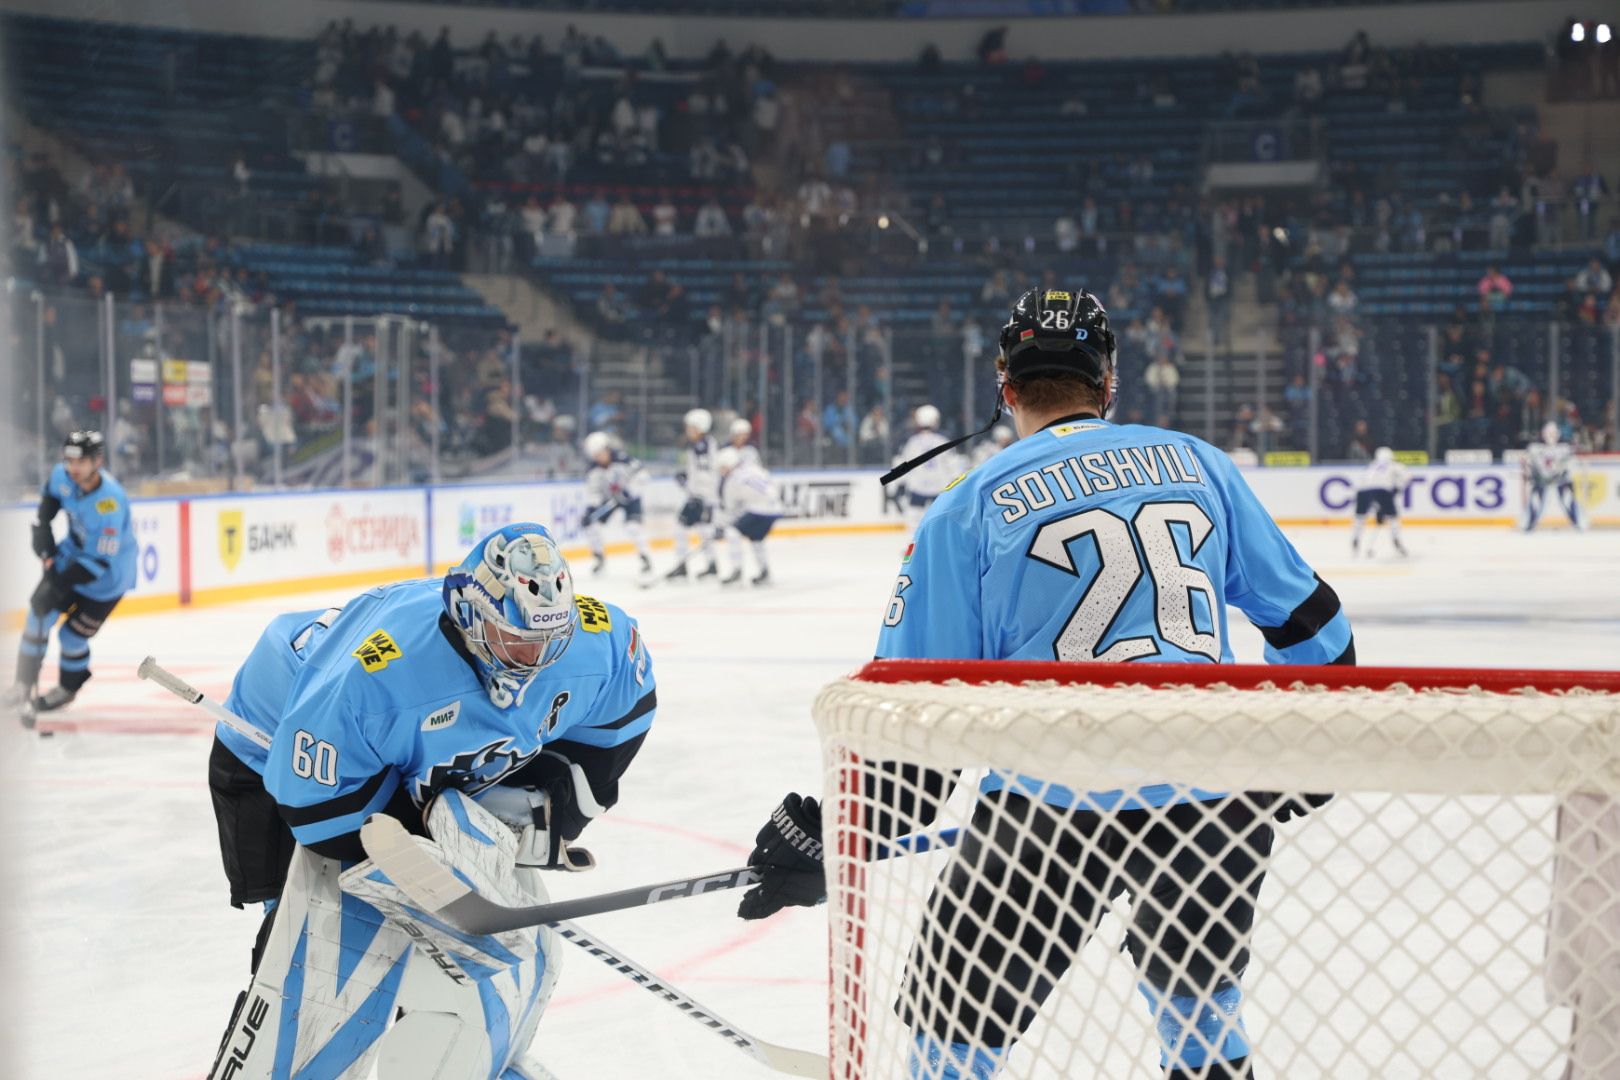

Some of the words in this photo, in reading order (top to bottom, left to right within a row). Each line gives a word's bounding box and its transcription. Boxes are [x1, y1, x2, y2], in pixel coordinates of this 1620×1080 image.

[1042, 310, 1069, 329] 26
[248, 521, 298, 552] БАНК
[1026, 501, 1222, 664] 26
[430, 710, 455, 726] МИР
[292, 729, 338, 787] 60
[394, 920, 466, 986] TRUE
[221, 994, 270, 1080] RUE
